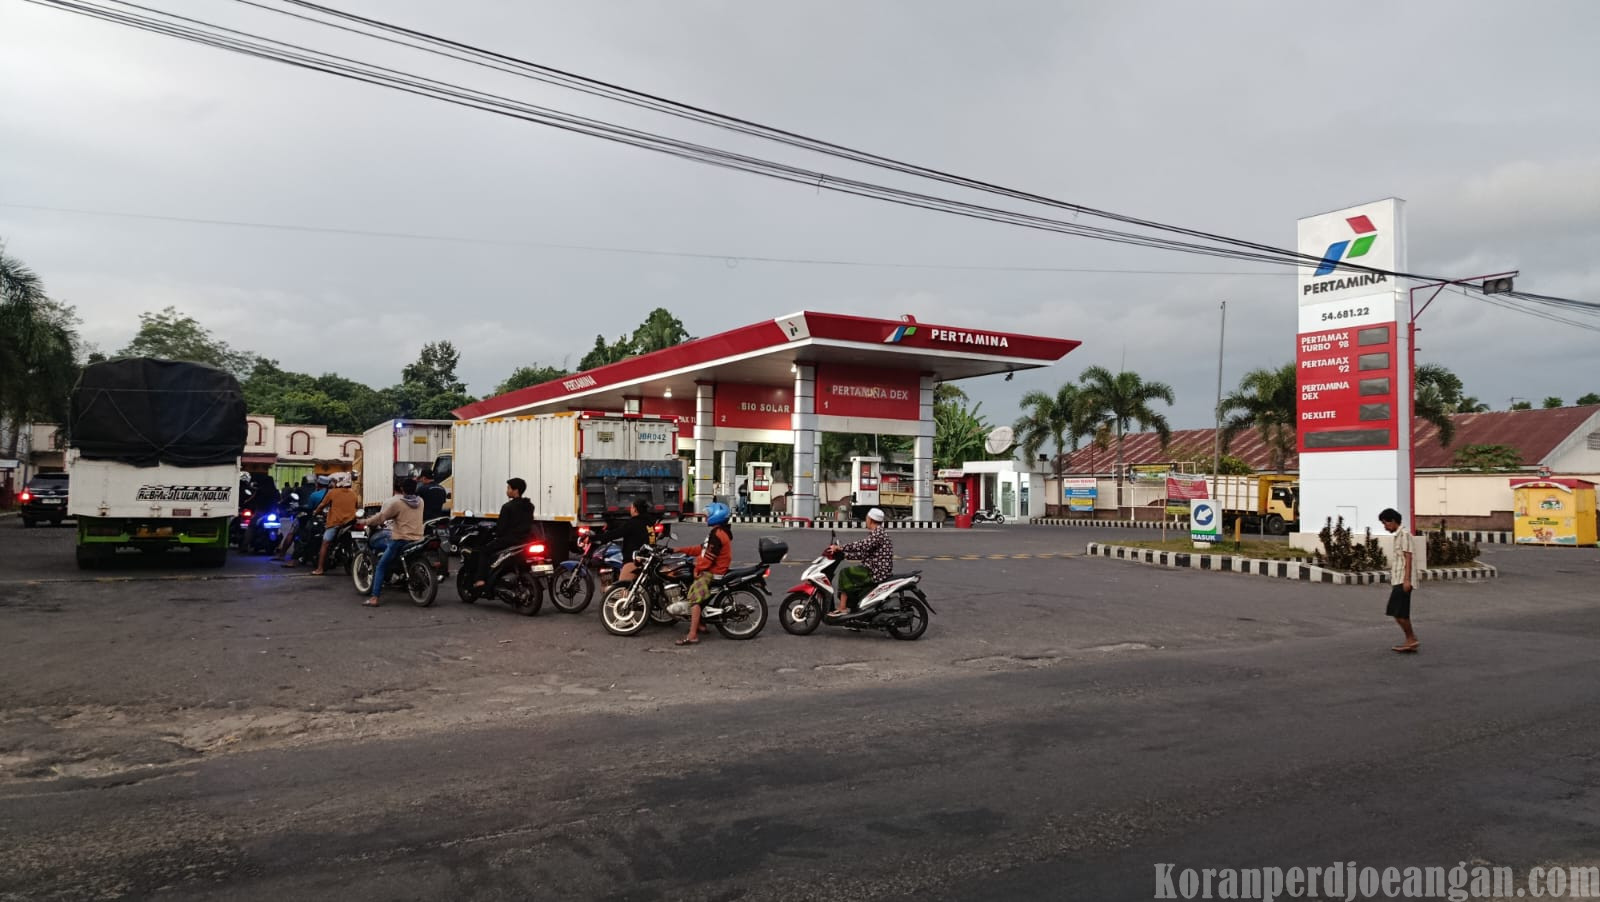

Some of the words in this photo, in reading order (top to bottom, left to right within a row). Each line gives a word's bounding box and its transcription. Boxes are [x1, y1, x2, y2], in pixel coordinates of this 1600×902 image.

[1303, 273, 1387, 295] PERTAMINA
[1321, 307, 1370, 322] 54.681.22
[931, 328, 1009, 348] PERTAMINA
[1301, 332, 1349, 345] PERTAMAX
[1301, 342, 1331, 353] TURBO
[1338, 340, 1350, 349] 98
[1301, 356, 1349, 369] PERTAMAX
[1338, 365, 1350, 373] 92
[562, 375, 597, 391] PERTAMINA
[1301, 381, 1350, 393] PERTAMINA
[889, 389, 909, 401] DEX
[1301, 392, 1319, 401] DEX
[741, 402, 757, 411] BIO
[760, 403, 790, 413] SOLAR
[824, 400, 829, 409] 1
[721, 415, 727, 423] 2
[1301, 410, 1337, 420] DEXLITE
[1191, 533, 1216, 541] MASUK
